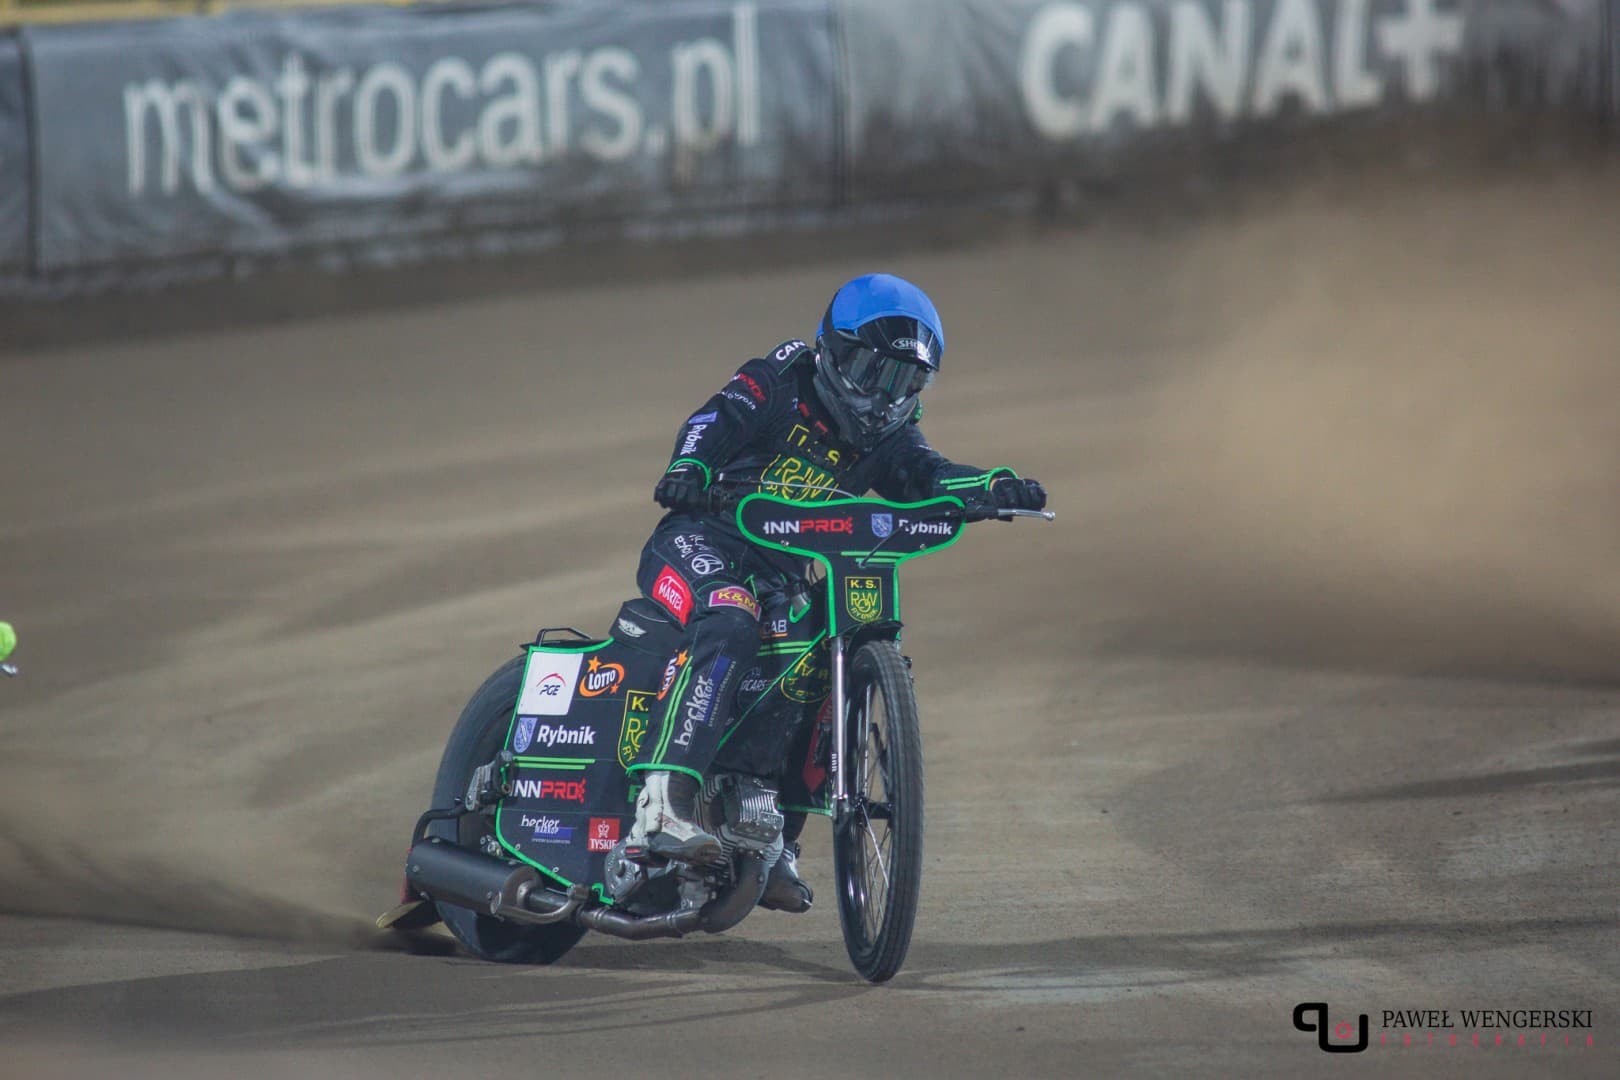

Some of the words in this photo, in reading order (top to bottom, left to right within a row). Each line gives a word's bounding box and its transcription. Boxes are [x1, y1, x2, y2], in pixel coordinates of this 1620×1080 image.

[1020, 0, 1466, 141] CANAL+
[123, 2, 761, 196] metrocars.pl
[539, 684, 561, 696] PGE
[588, 669, 616, 691] LOTTO
[536, 724, 597, 748] Rybnik
